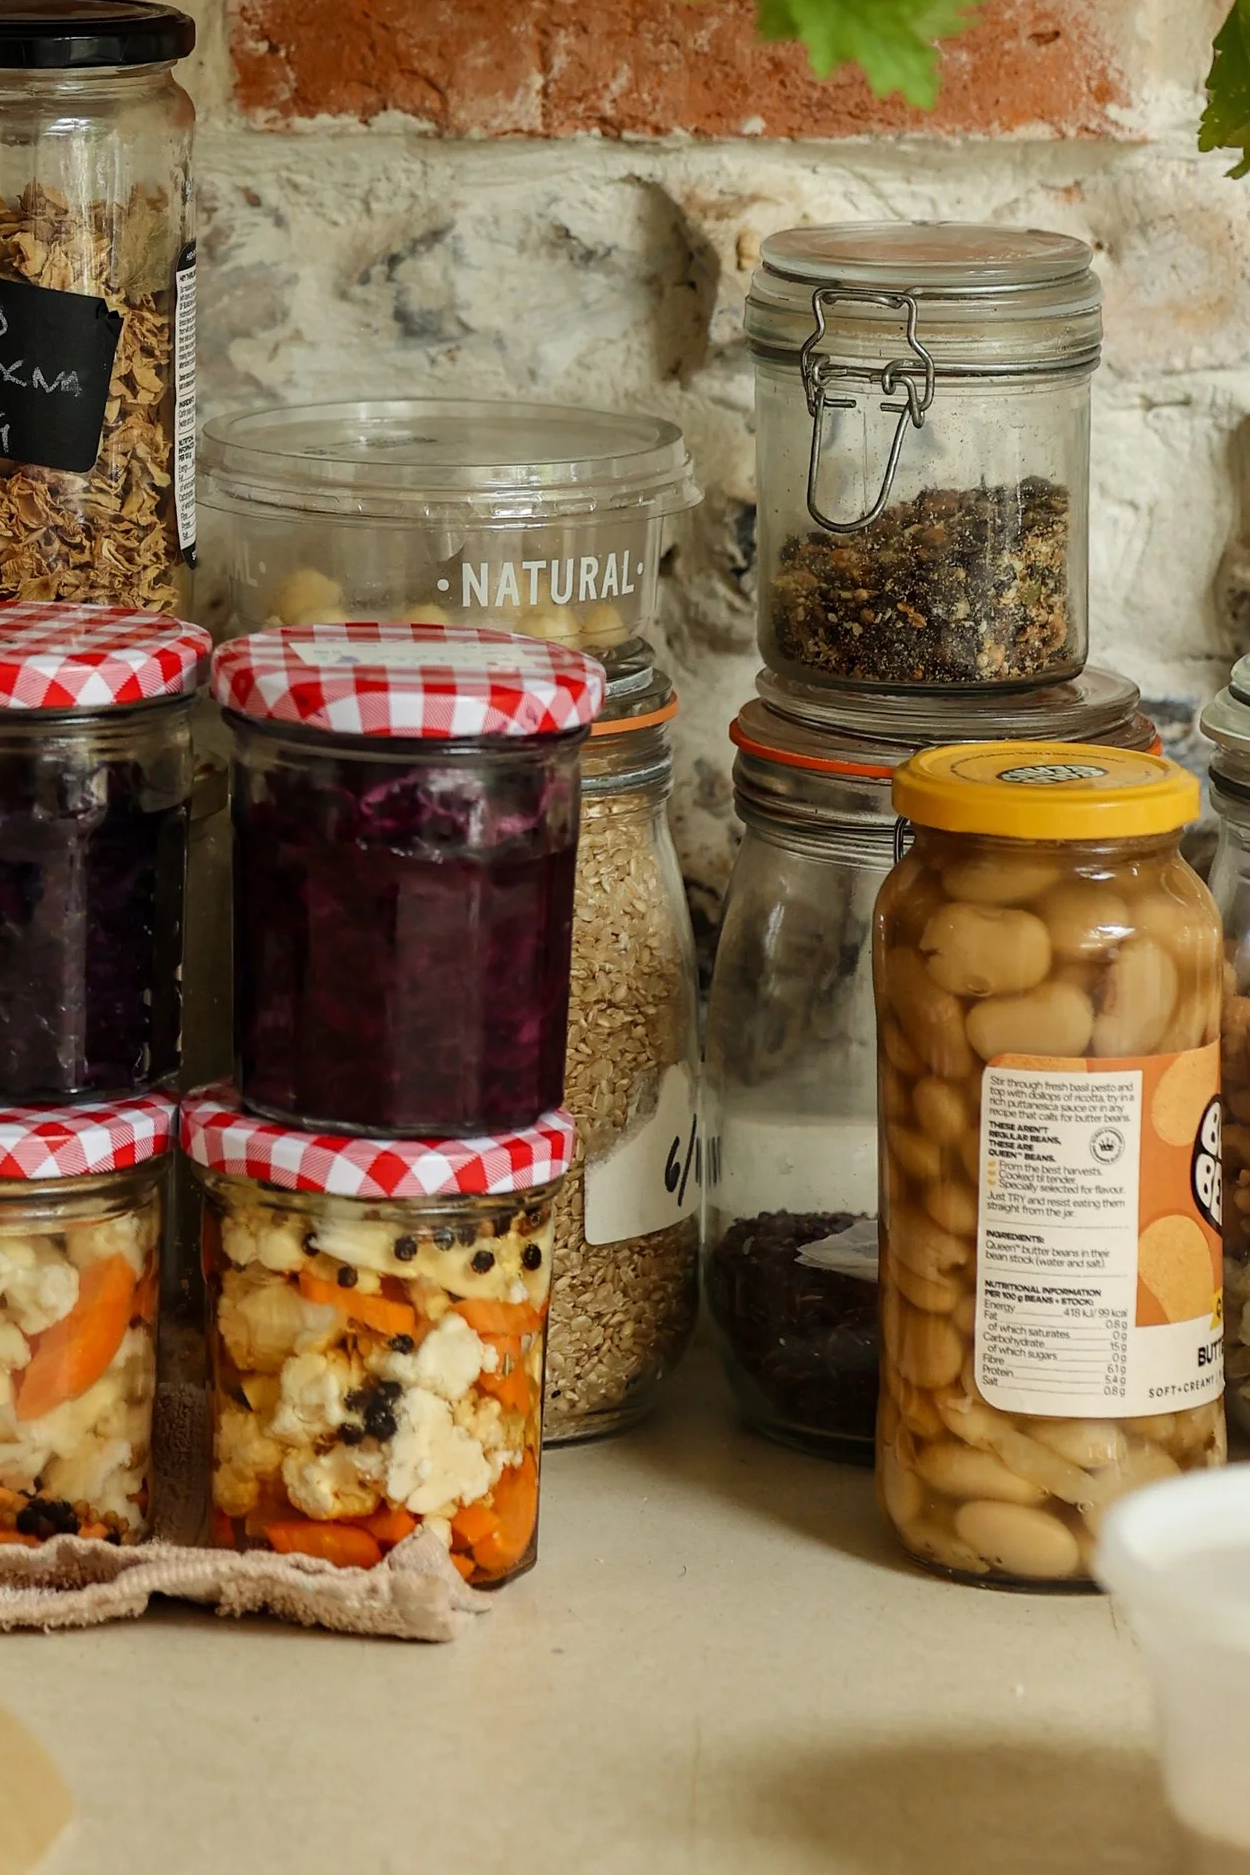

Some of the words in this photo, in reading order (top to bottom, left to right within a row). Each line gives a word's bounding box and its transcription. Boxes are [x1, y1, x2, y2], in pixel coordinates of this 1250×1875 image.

[1007, 1077, 1043, 1092] through
[1045, 1080, 1068, 1091] fresh
[1070, 1082, 1089, 1091] basil
[1091, 1083, 1116, 1094] pesto
[1118, 1083, 1133, 1091] and
[990, 1087, 1005, 1097] top
[1007, 1089, 1027, 1099] with
[1029, 1090, 1061, 1102] dollops
[1063, 1093, 1073, 1102] of
[1107, 1094, 1119, 1103] try
[990, 1097, 1006, 1106] rich
[1008, 1100, 1059, 1111] puttanesca
[1061, 1105, 1087, 1113] sauce
[1109, 1105, 1123, 1114] any
[989, 1108, 1017, 1118] recipe
[1019, 1109, 1037, 1120] that
[1039, 1111, 1058, 1121] calls
[1060, 1113, 1073, 1122] for
[1075, 1113, 1100, 1122] butter
[989, 1121, 1015, 1131] THESE
[989, 1130, 1029, 1142] REGULAR
[989, 1139, 1015, 1149] THESE
[1017, 1142, 1034, 1151] ARE
[999, 1170, 1034, 1182] Cooked
[1000, 1162, 1023, 1173] From
[1025, 1163, 1039, 1174] the
[1041, 1165, 1062, 1175] best
[999, 1179, 1037, 1192] Specially
[1040, 1184, 1078, 1194] selected
[1081, 1185, 1093, 1194] for
[987, 1191, 1006, 1201] Just
[1008, 1193, 1026, 1203] TRY
[1028, 1196, 1045, 1205] and
[1047, 1197, 1071, 1207] resist
[1073, 1199, 1100, 1209] eating
[1102, 1198, 1125, 1207] them
[987, 1202, 1019, 1214] straight
[1023, 1206, 1044, 1215] from
[1046, 1207, 1061, 1217] the
[1022, 1244, 1050, 1256] butter
[1052, 1248, 1079, 1257] beans
[1091, 1249, 1110, 1258] their
[985, 1251, 1008, 1261] bean
[1010, 1254, 1034, 1265] stock
[1036, 1256, 1064, 1267] (water
[1067, 1258, 1084, 1268] and
[985, 1280, 1040, 1294] NUTRITIONAL
[1042, 1287, 1101, 1297] INFORMATION
[985, 1289, 1001, 1298] PER
[1003, 1292, 1016, 1300] 100
[1025, 1295, 1052, 1304] BEANS
[984, 1299, 1016, 1314] Energy
[1064, 1309, 1081, 1317] 418
[1111, 1309, 1128, 1318] kcal
[984, 1310, 998, 1320] Fat
[988, 1323, 997, 1331] of
[1000, 1324, 1027, 1335] which
[1028, 1329, 1071, 1339] saturates
[983, 1332, 1045, 1348] Carbohydrate
[1110, 1341, 1120, 1351] 15
[983, 1353, 1005, 1365] Fibre
[988, 1344, 998, 1352] of
[999, 1347, 1026, 1357] which
[1028, 1350, 1058, 1362] sugars
[983, 1364, 1014, 1377] Protein
[982, 1375, 998, 1387] Salt
